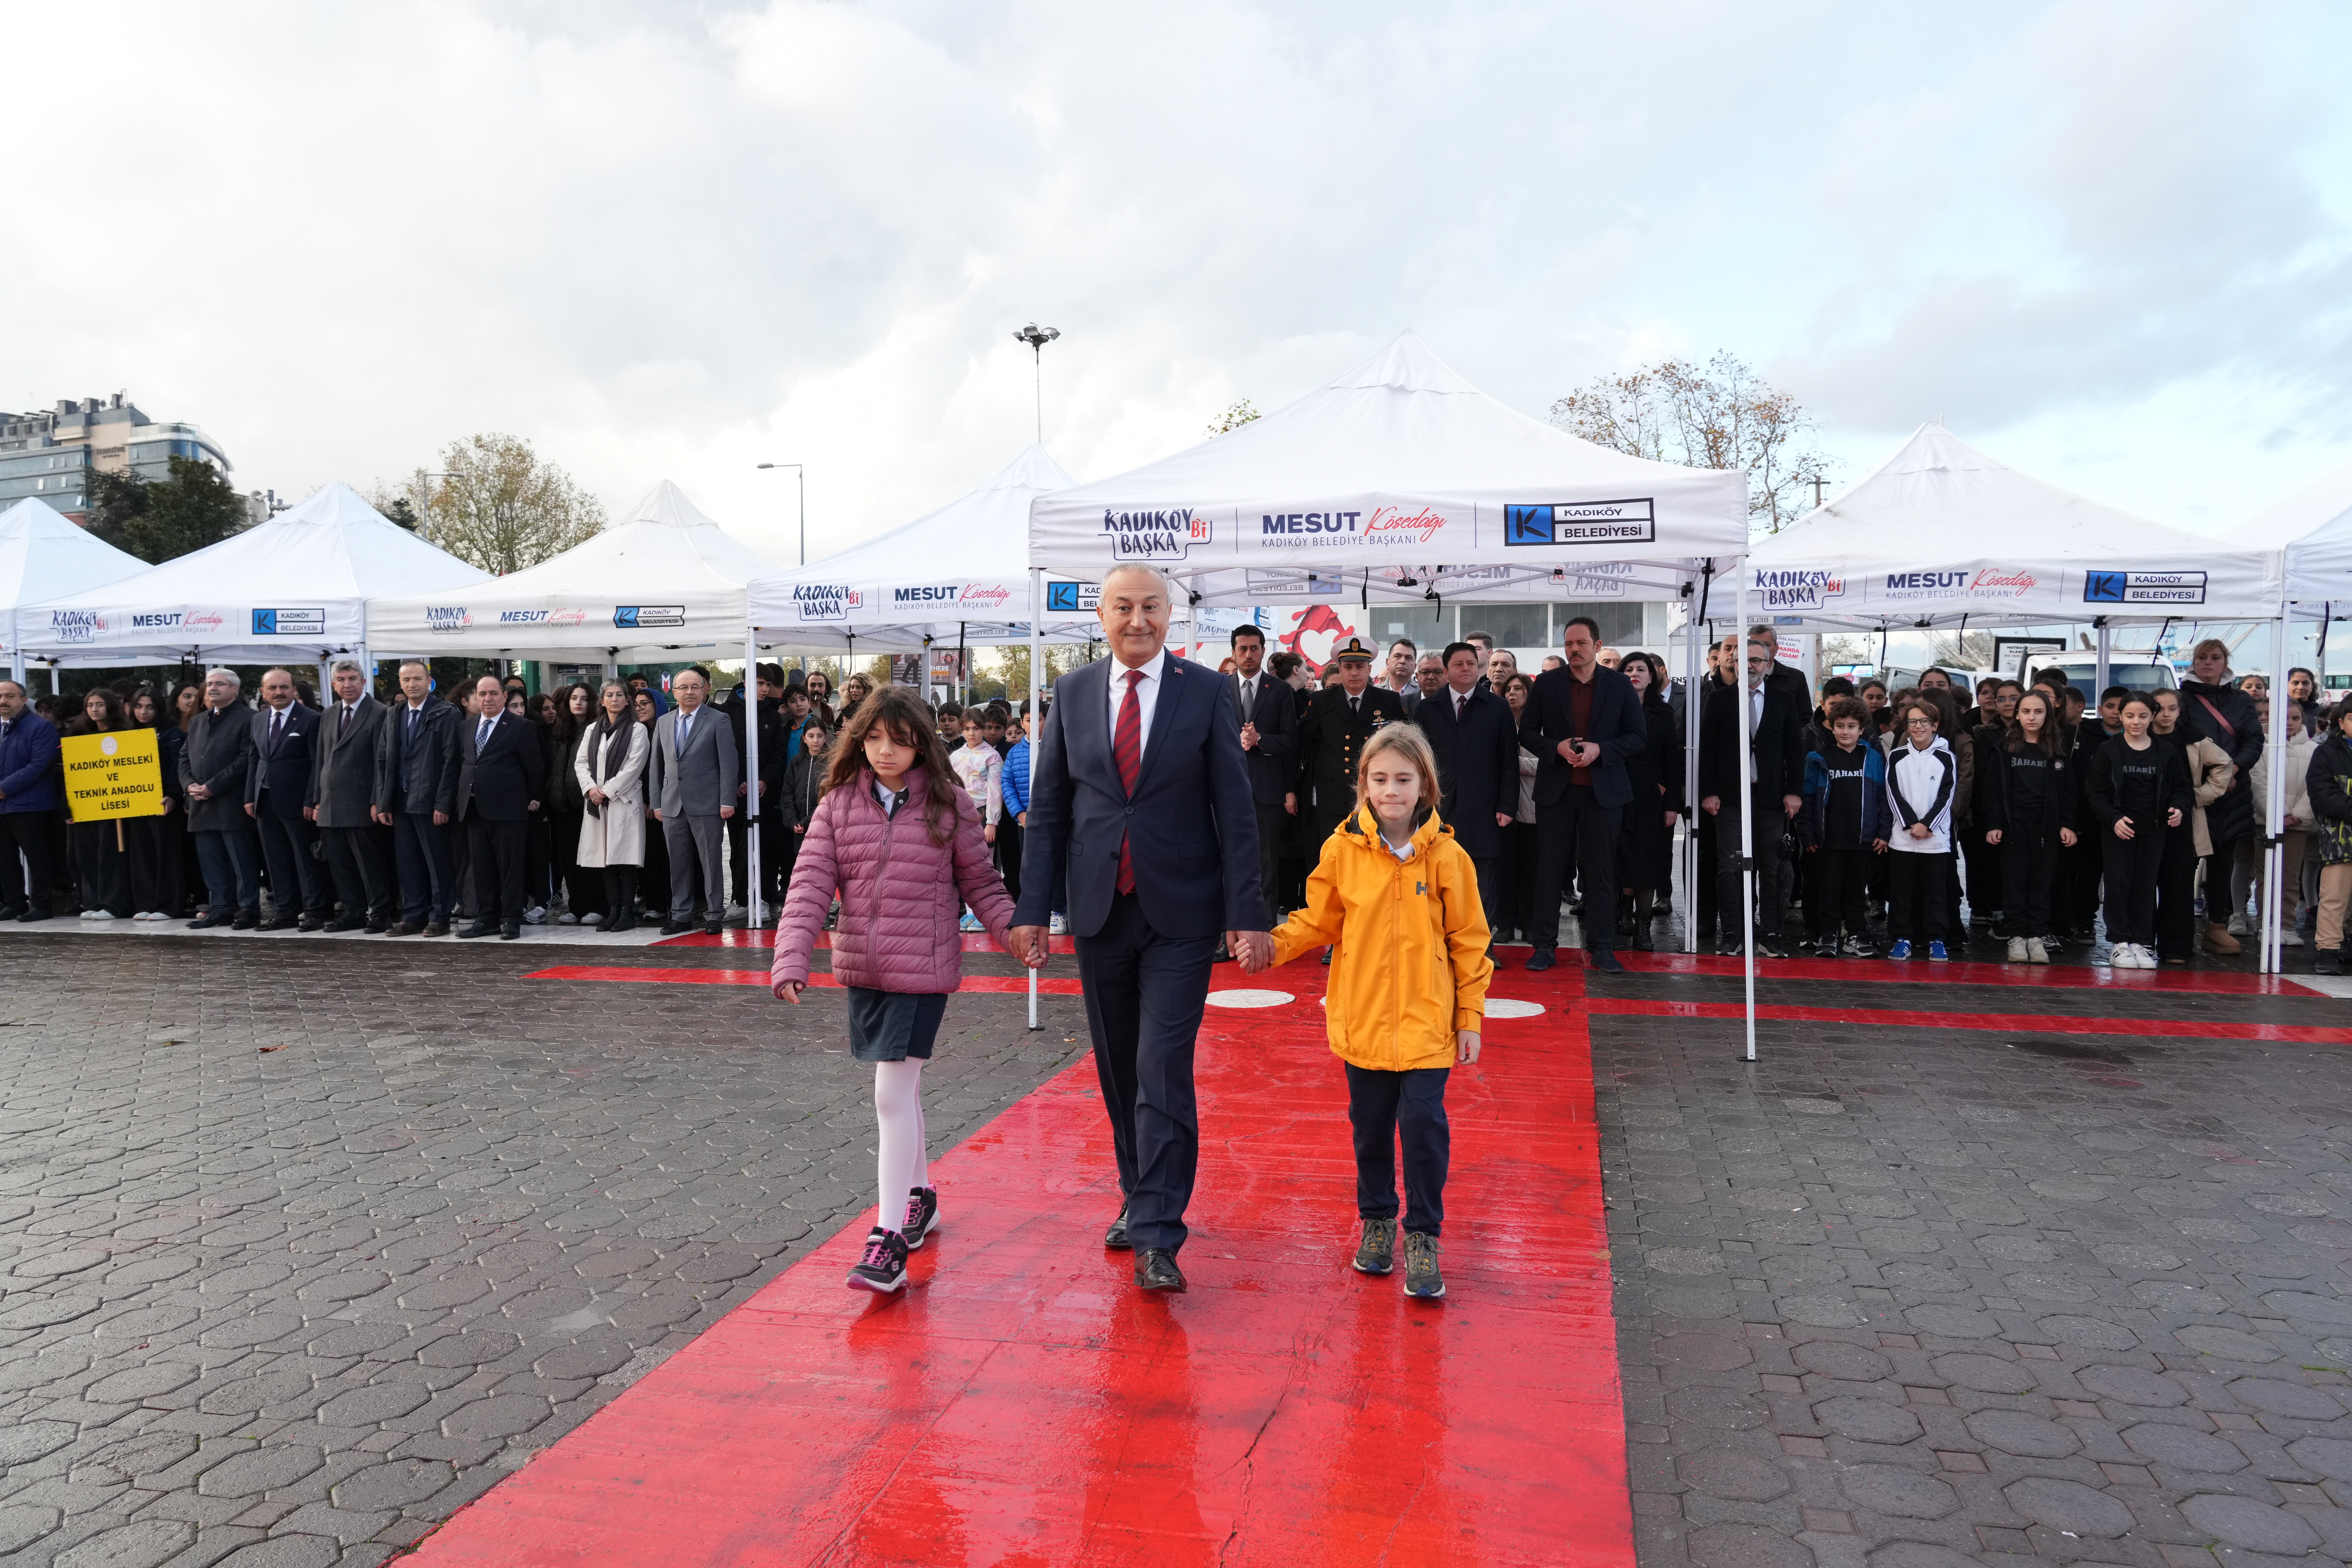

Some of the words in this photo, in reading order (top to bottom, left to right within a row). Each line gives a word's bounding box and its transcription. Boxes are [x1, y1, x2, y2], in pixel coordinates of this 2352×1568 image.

[1564, 507, 1622, 516] KADIKÖY
[1104, 508, 1194, 532] KADIKÖY
[1263, 512, 1361, 534] MESUT
[1364, 506, 1447, 542] Kösedağı
[1565, 524, 1642, 538] BELEDİYESİ
[1119, 532, 1179, 557] BAŞKA
[1262, 536, 1308, 547] KADIKÖY
[1313, 534, 1363, 546] BELEDİYE
[1370, 535, 1416, 547] BAŞKANI
[1756, 570, 1831, 588] KADIKÖY
[1887, 572, 1968, 588] MESUT
[1971, 568, 2039, 596] Kösedağı
[793, 585, 854, 600] KADIKÖY
[895, 586, 957, 601] MESUT
[959, 583, 1012, 607] Kösedağı
[1769, 587, 1817, 607] BAŞKA
[1886, 590, 1923, 599] KADIKÖY
[1928, 589, 1969, 598] BELEDİYE
[1975, 590, 2012, 599] BAŞKANI
[2132, 590, 2195, 599] BELEDİYESİ
[427, 606, 467, 620] KADIKÖY
[500, 611, 548, 622] MESUT
[548, 608, 588, 626] Kösedağı
[803, 600, 842, 618] BAŞKA
[53, 610, 101, 626] KADIKÖY
[133, 614, 182, 626] MESUT
[184, 611, 224, 631] Kösedağı
[433, 620, 460, 632] BAŞKA
[61, 626, 90, 641] BAŞKA
[70, 759, 110, 771] KADIKÖY
[113, 753, 153, 766] MESLEKİ
[2012, 757, 2046, 767] BAHARİ
[1829, 769, 1862, 779] BAHARİ
[74, 787, 108, 799] TEKNİK
[111, 783, 154, 795] ANADOLU
[101, 798, 129, 810] LİSESİ
